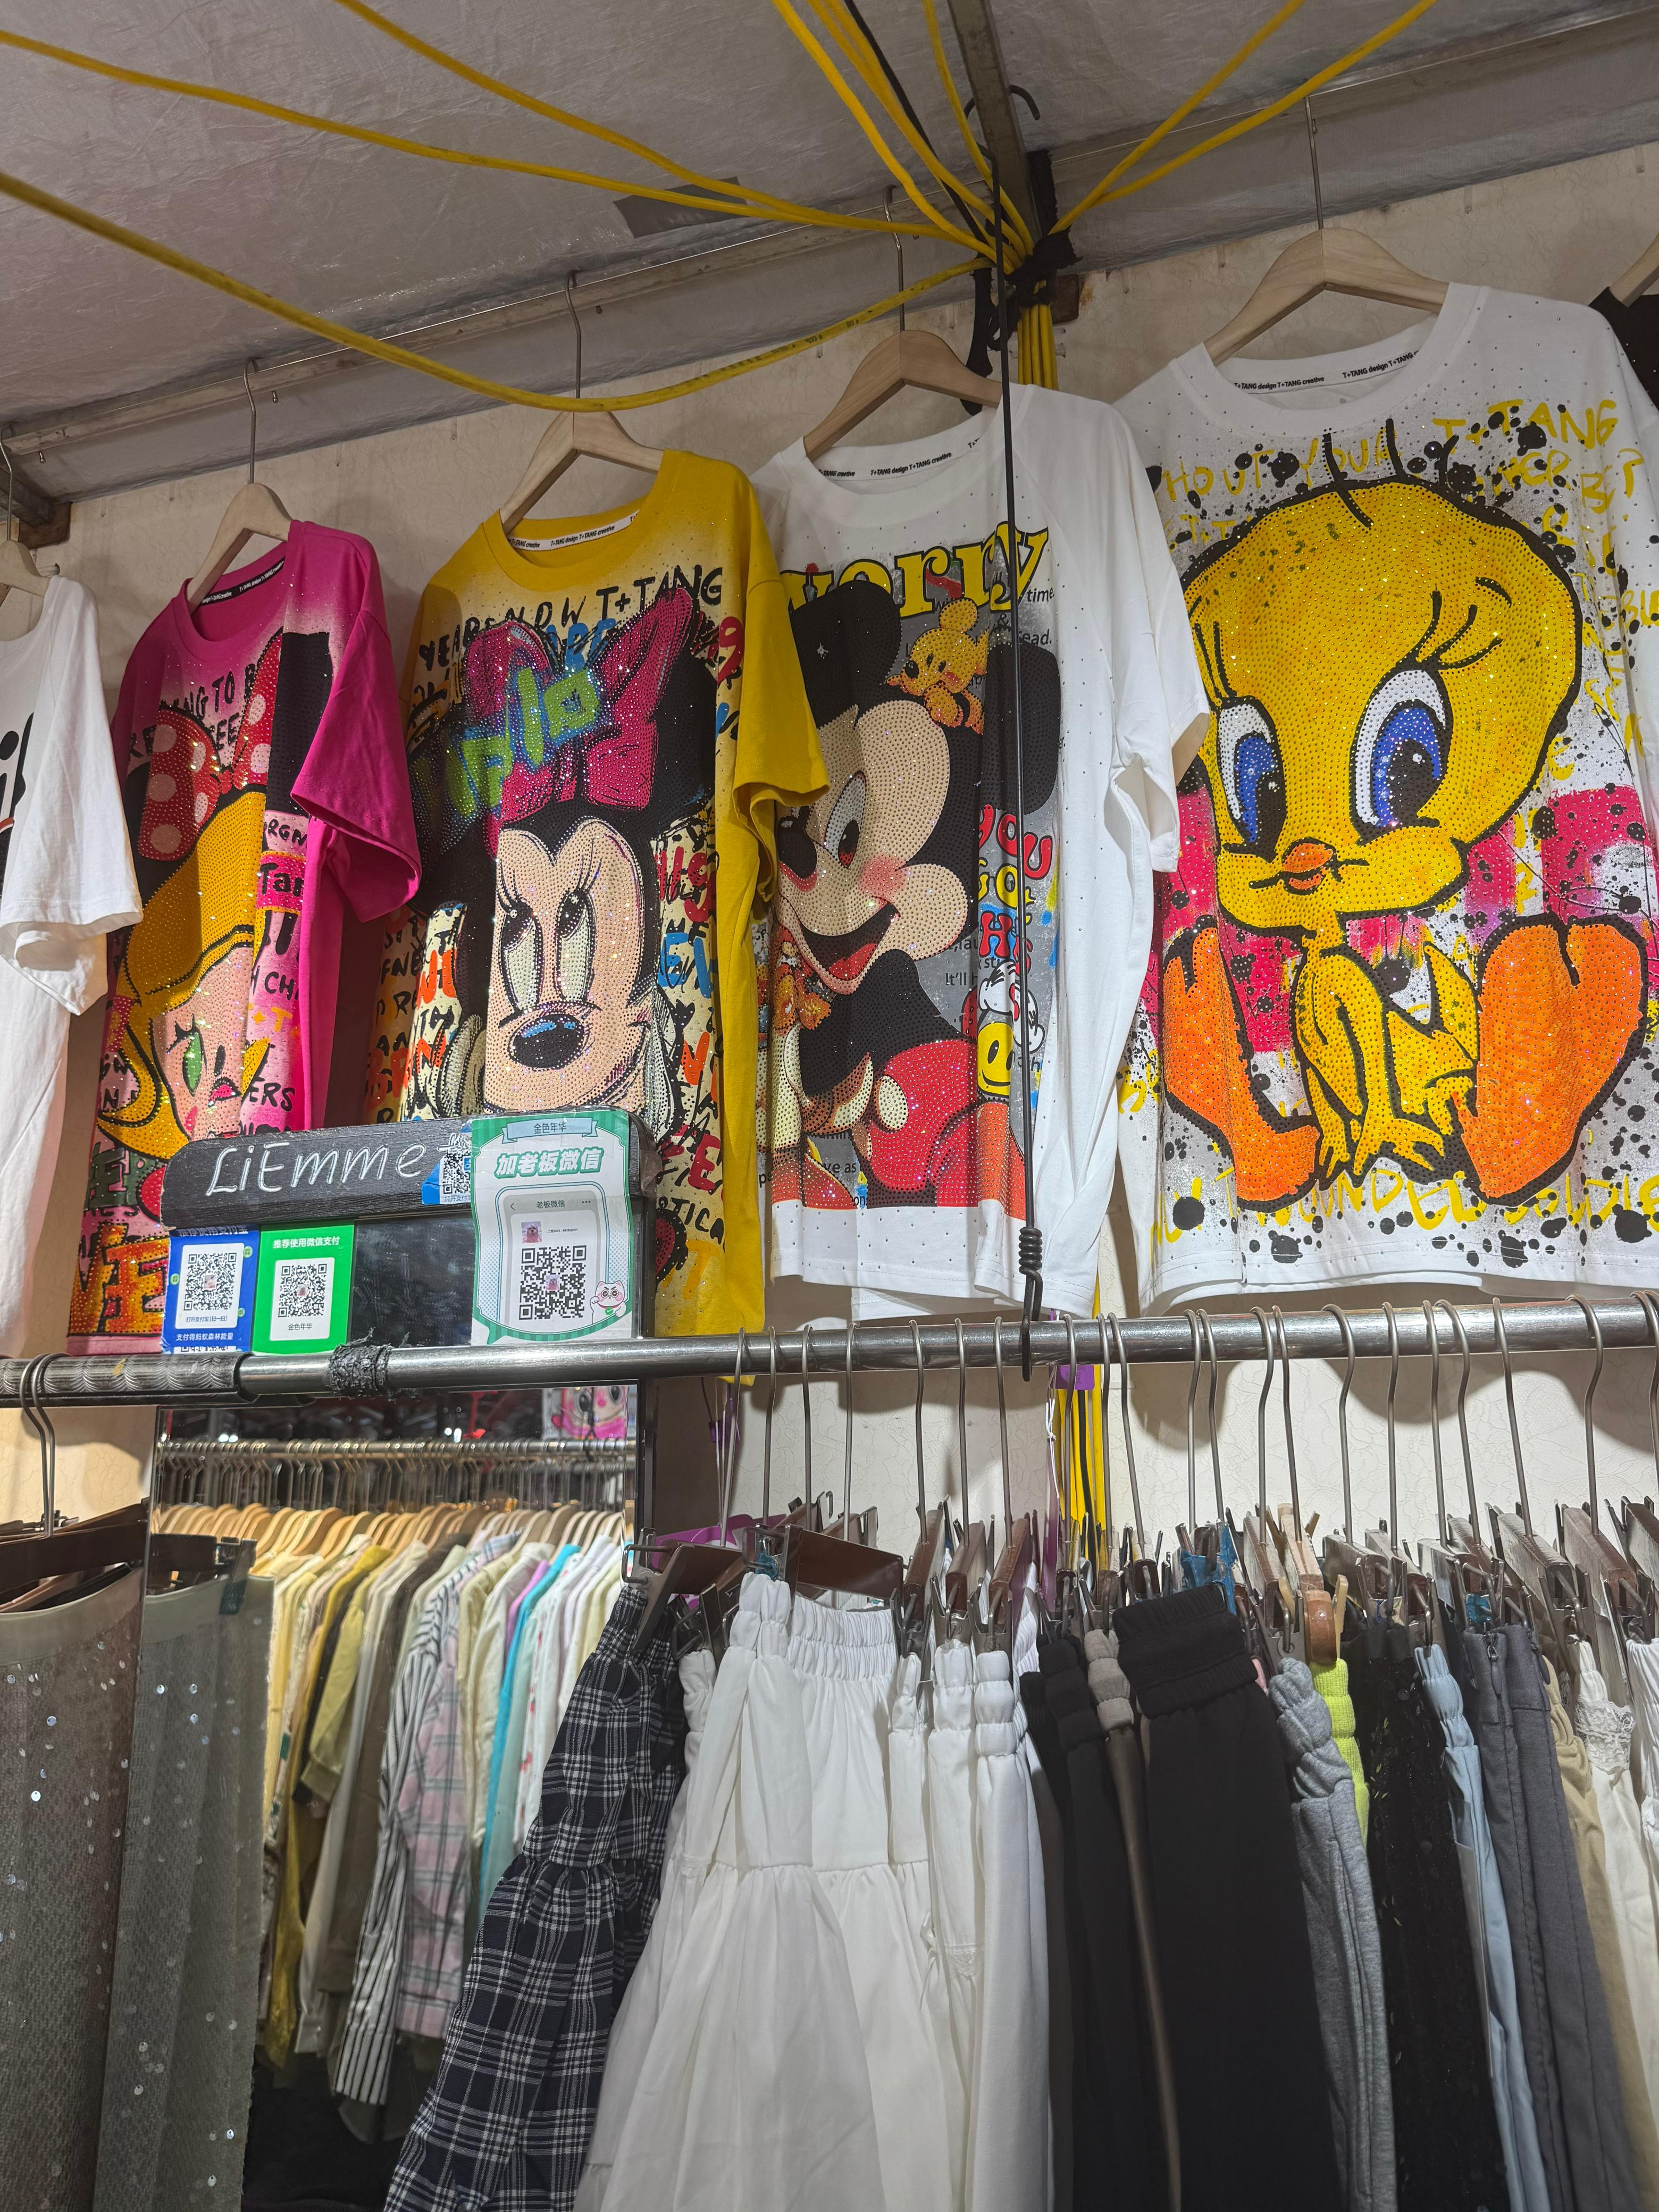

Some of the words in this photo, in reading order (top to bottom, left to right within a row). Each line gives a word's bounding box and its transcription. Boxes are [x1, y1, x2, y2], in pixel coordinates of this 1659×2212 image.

[1343, 367, 1368, 379] T+TANG
[1369, 362, 1388, 373] design
[1389, 352, 1413, 367] T+TANG
[1277, 379, 1301, 388] T+TANG
[1302, 376, 1325, 385] creative
[892, 465, 908, 474] design
[909, 459, 931, 471] T+TANG
[932, 452, 952, 464] creative
[1027, 586, 1055, 603] time.
[212, 670, 236, 713] TO
[945, 972, 967, 986] It'll
[533, 1121, 566, 1134] 金色年华
[495, 1146, 604, 1179] 加老板微信
[536, 1200, 565, 1209] 老板微信
[273, 1236, 340, 1249] 推荐使用微信支付
[176, 1332, 233, 1341] 支付得蚂蚁森林能量
